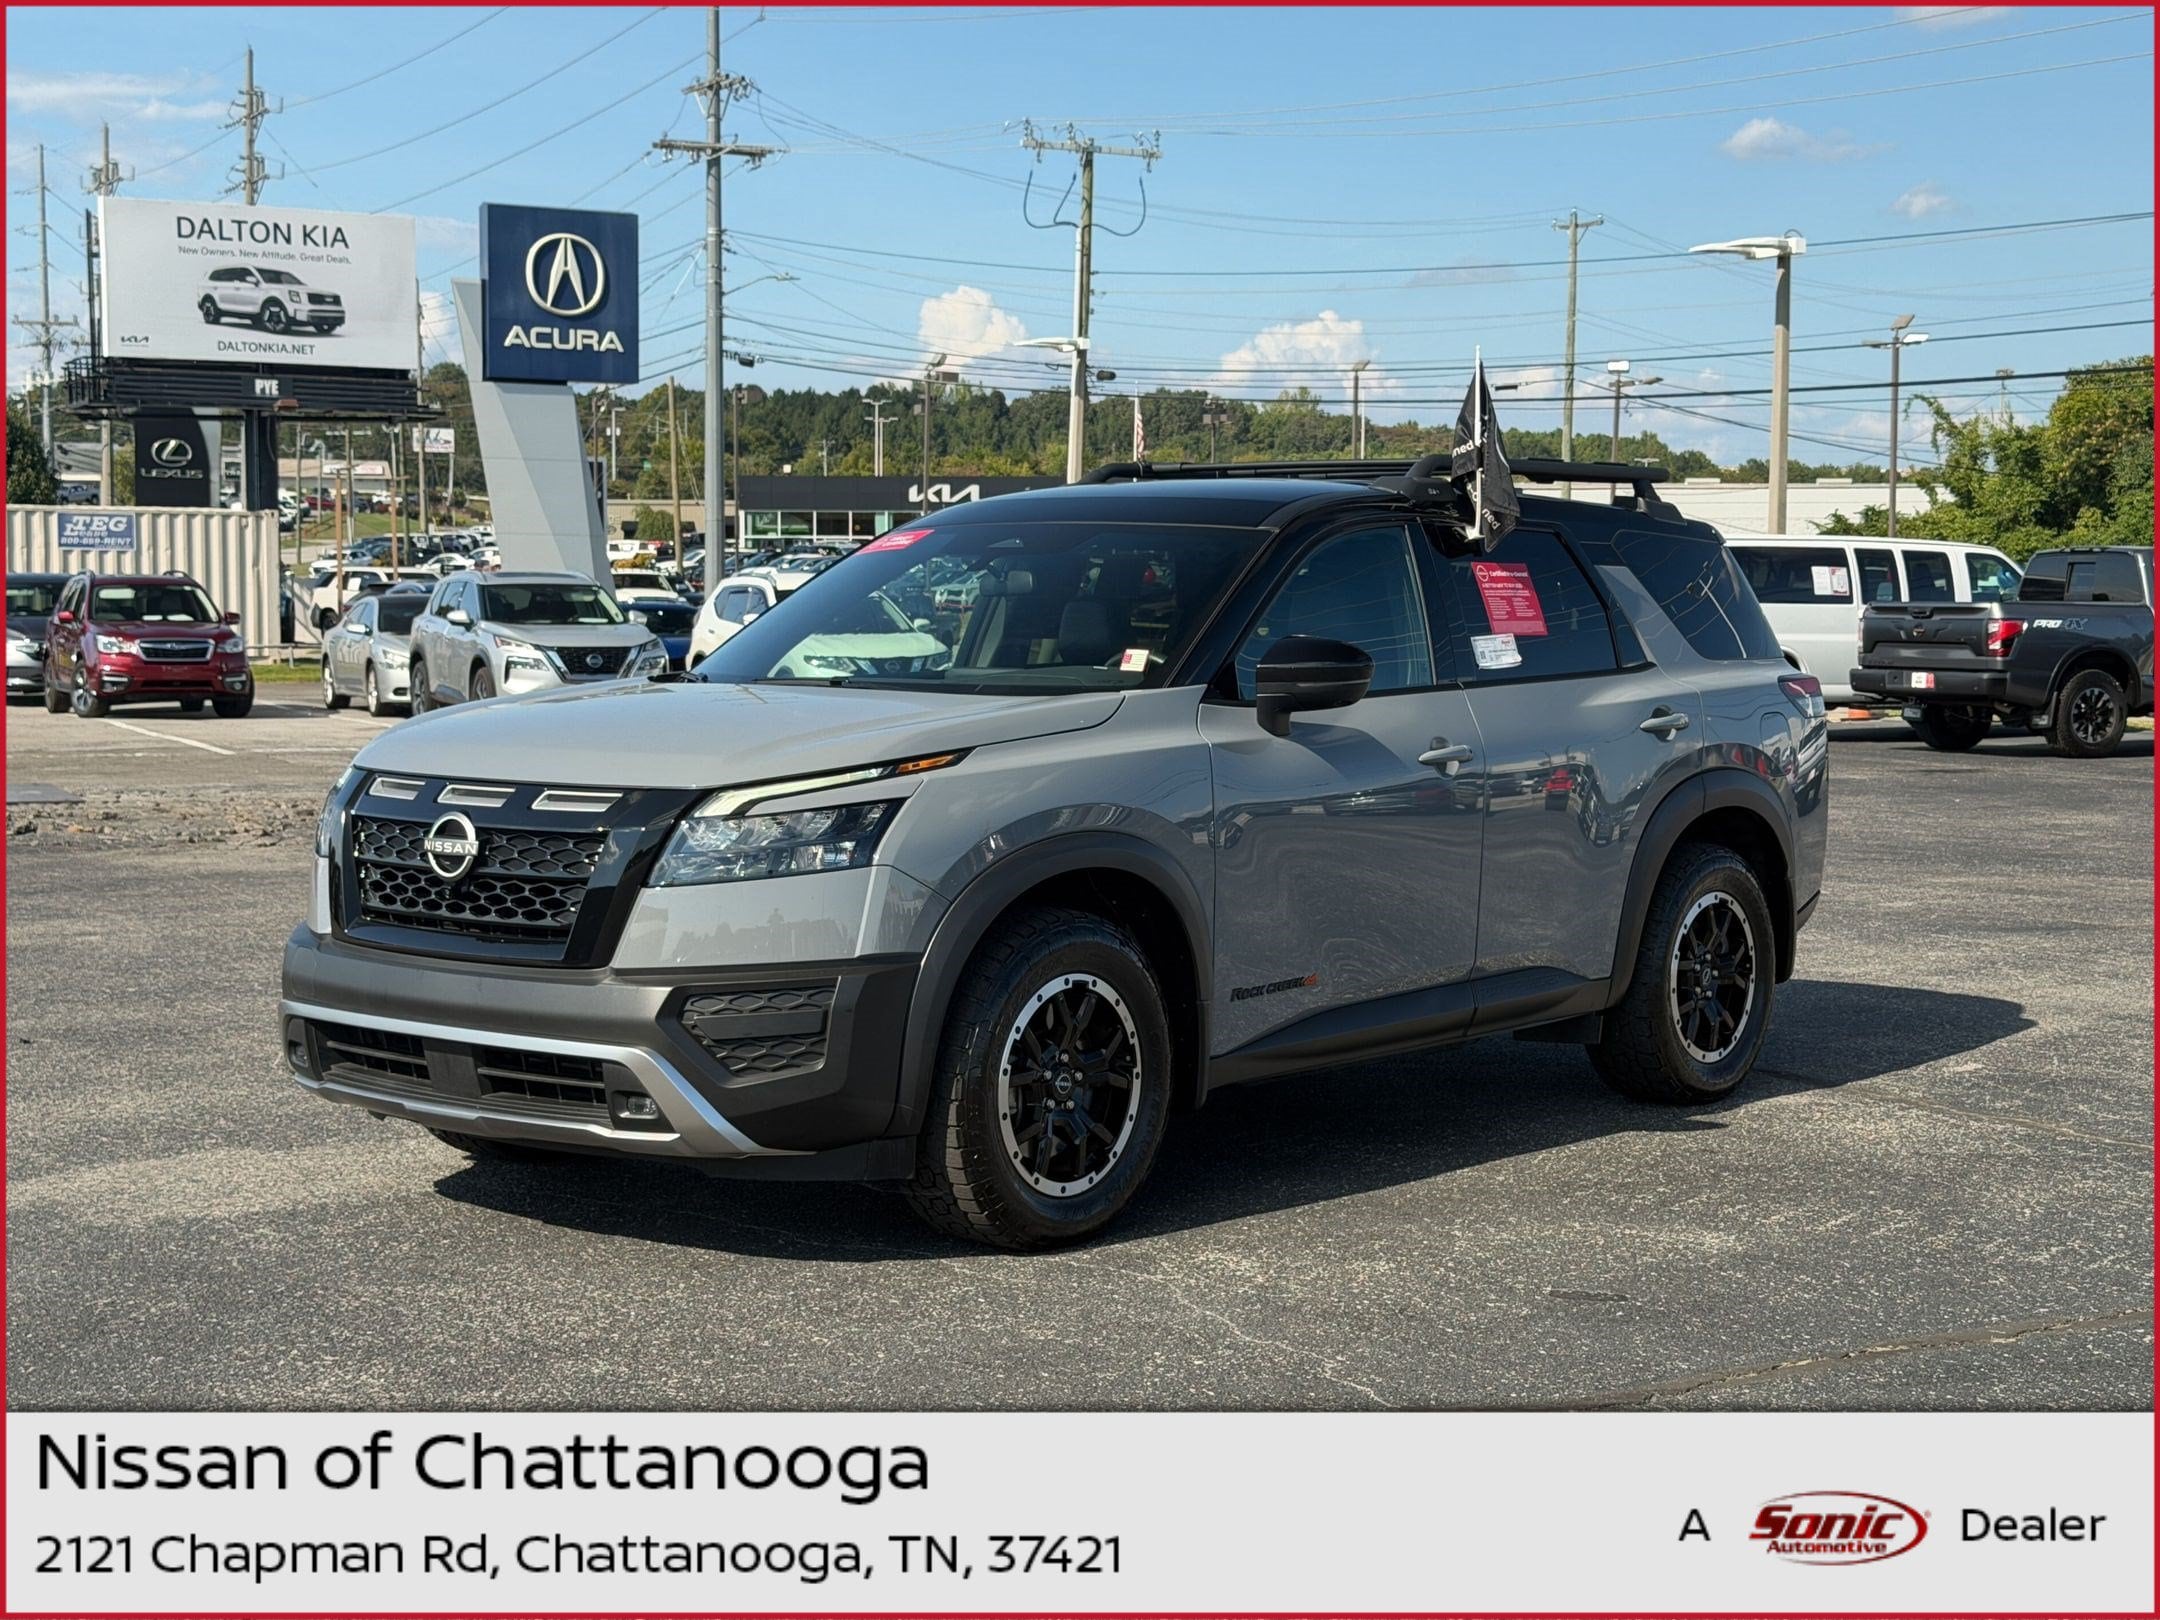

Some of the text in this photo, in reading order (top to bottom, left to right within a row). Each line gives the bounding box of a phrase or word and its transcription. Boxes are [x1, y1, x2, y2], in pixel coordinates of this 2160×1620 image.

[176, 216, 350, 250] DALTON KIA
[178, 246, 352, 265] New Owners. New Attitude. Great Deals.
[121, 336, 150, 344] KIA
[217, 340, 316, 356] DALTONKIA.NET
[504, 325, 625, 353] ACURA
[255, 378, 279, 397] PYE
[140, 468, 204, 479] LEXUS
[908, 484, 980, 503] KIA
[72, 515, 128, 532] TEG
[424, 839, 477, 855] NISSAN
